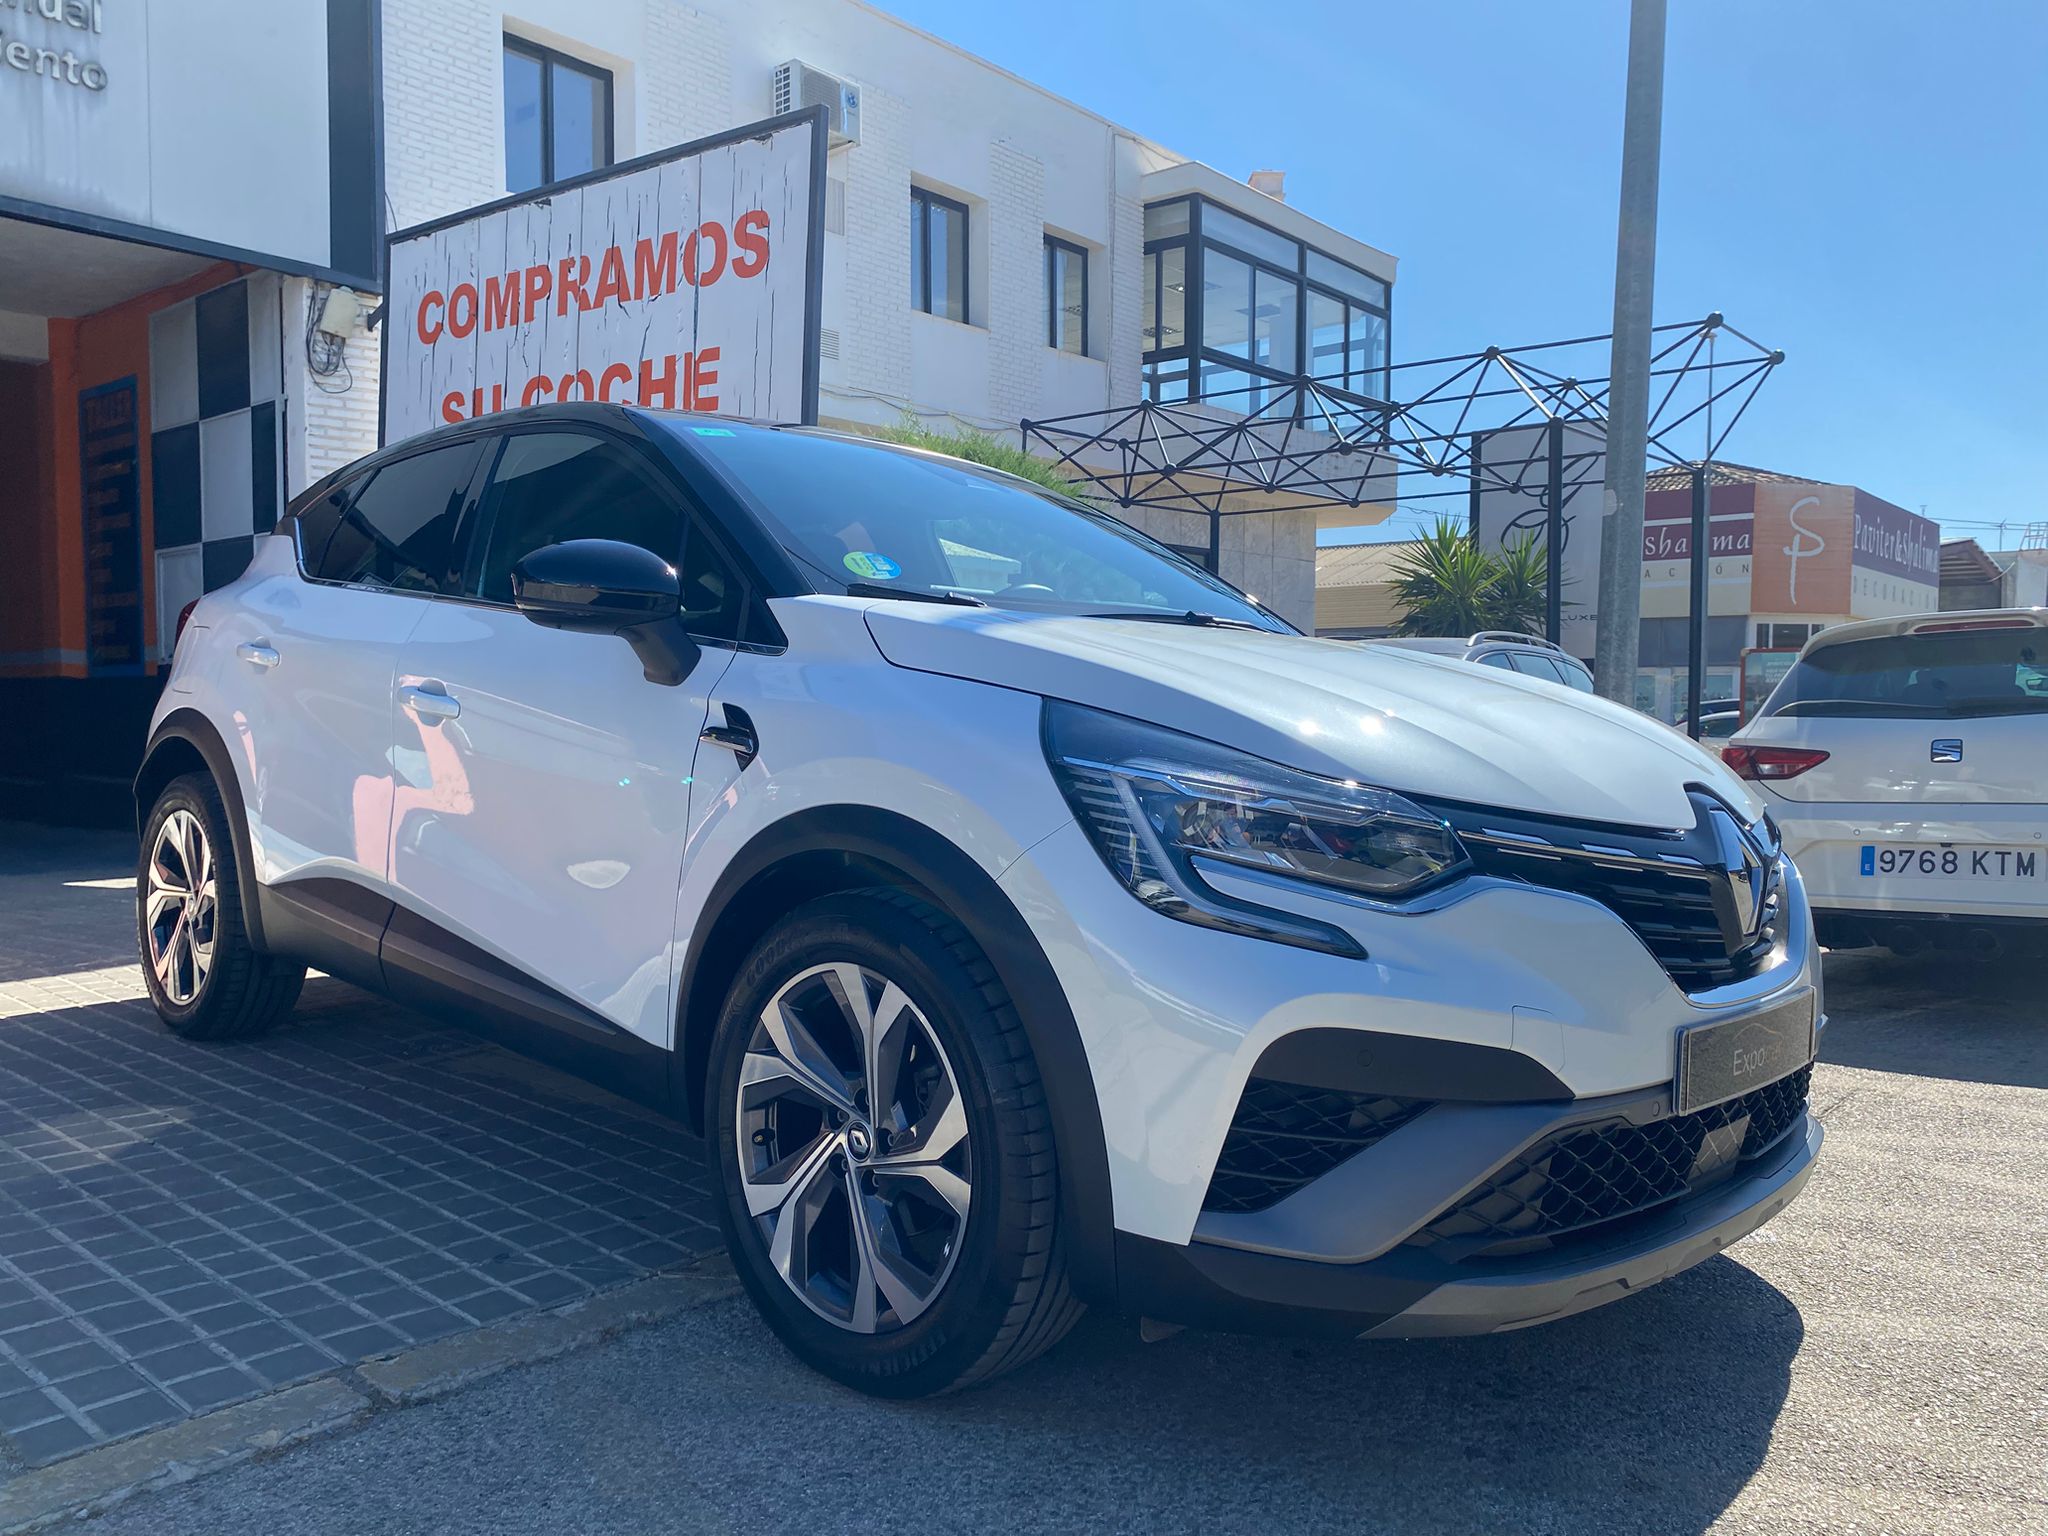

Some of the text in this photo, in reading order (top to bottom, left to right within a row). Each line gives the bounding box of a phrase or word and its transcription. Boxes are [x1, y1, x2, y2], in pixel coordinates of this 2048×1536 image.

[0, 32, 108, 92] ento
[417, 209, 770, 345] COMPRAMOS
[521, 346, 721, 412] COCHE
[1644, 526, 1750, 558] Shama
[1864, 849, 2036, 877] E 9768 KTM
